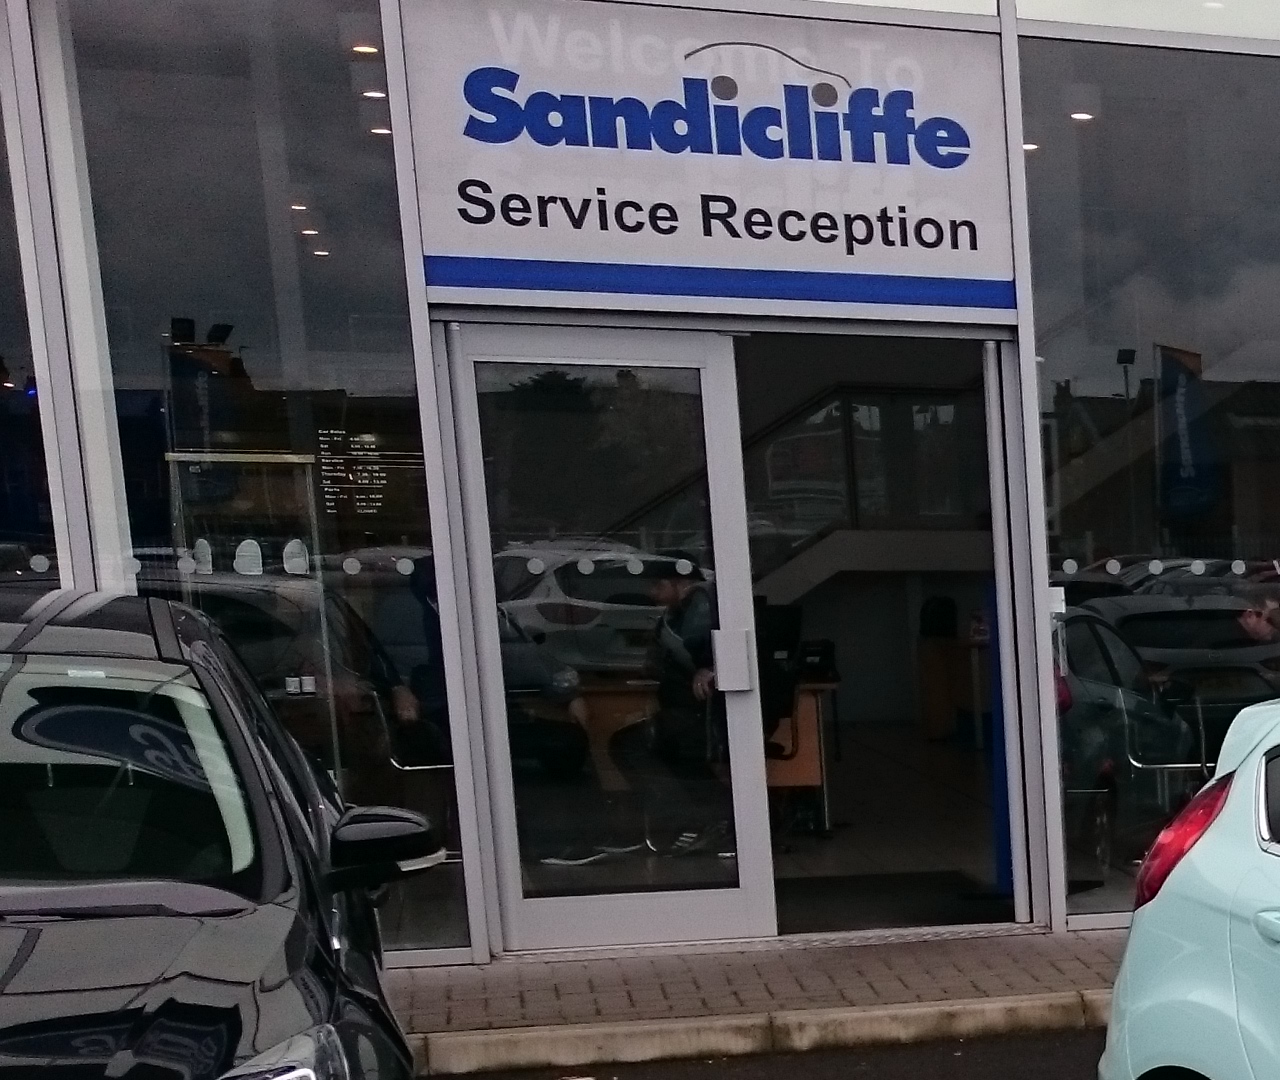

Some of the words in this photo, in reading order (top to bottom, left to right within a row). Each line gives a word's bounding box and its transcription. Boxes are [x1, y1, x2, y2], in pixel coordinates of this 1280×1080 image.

[462, 66, 971, 170] Sandicliffe
[456, 178, 680, 236] Service
[700, 193, 980, 256] Reception
